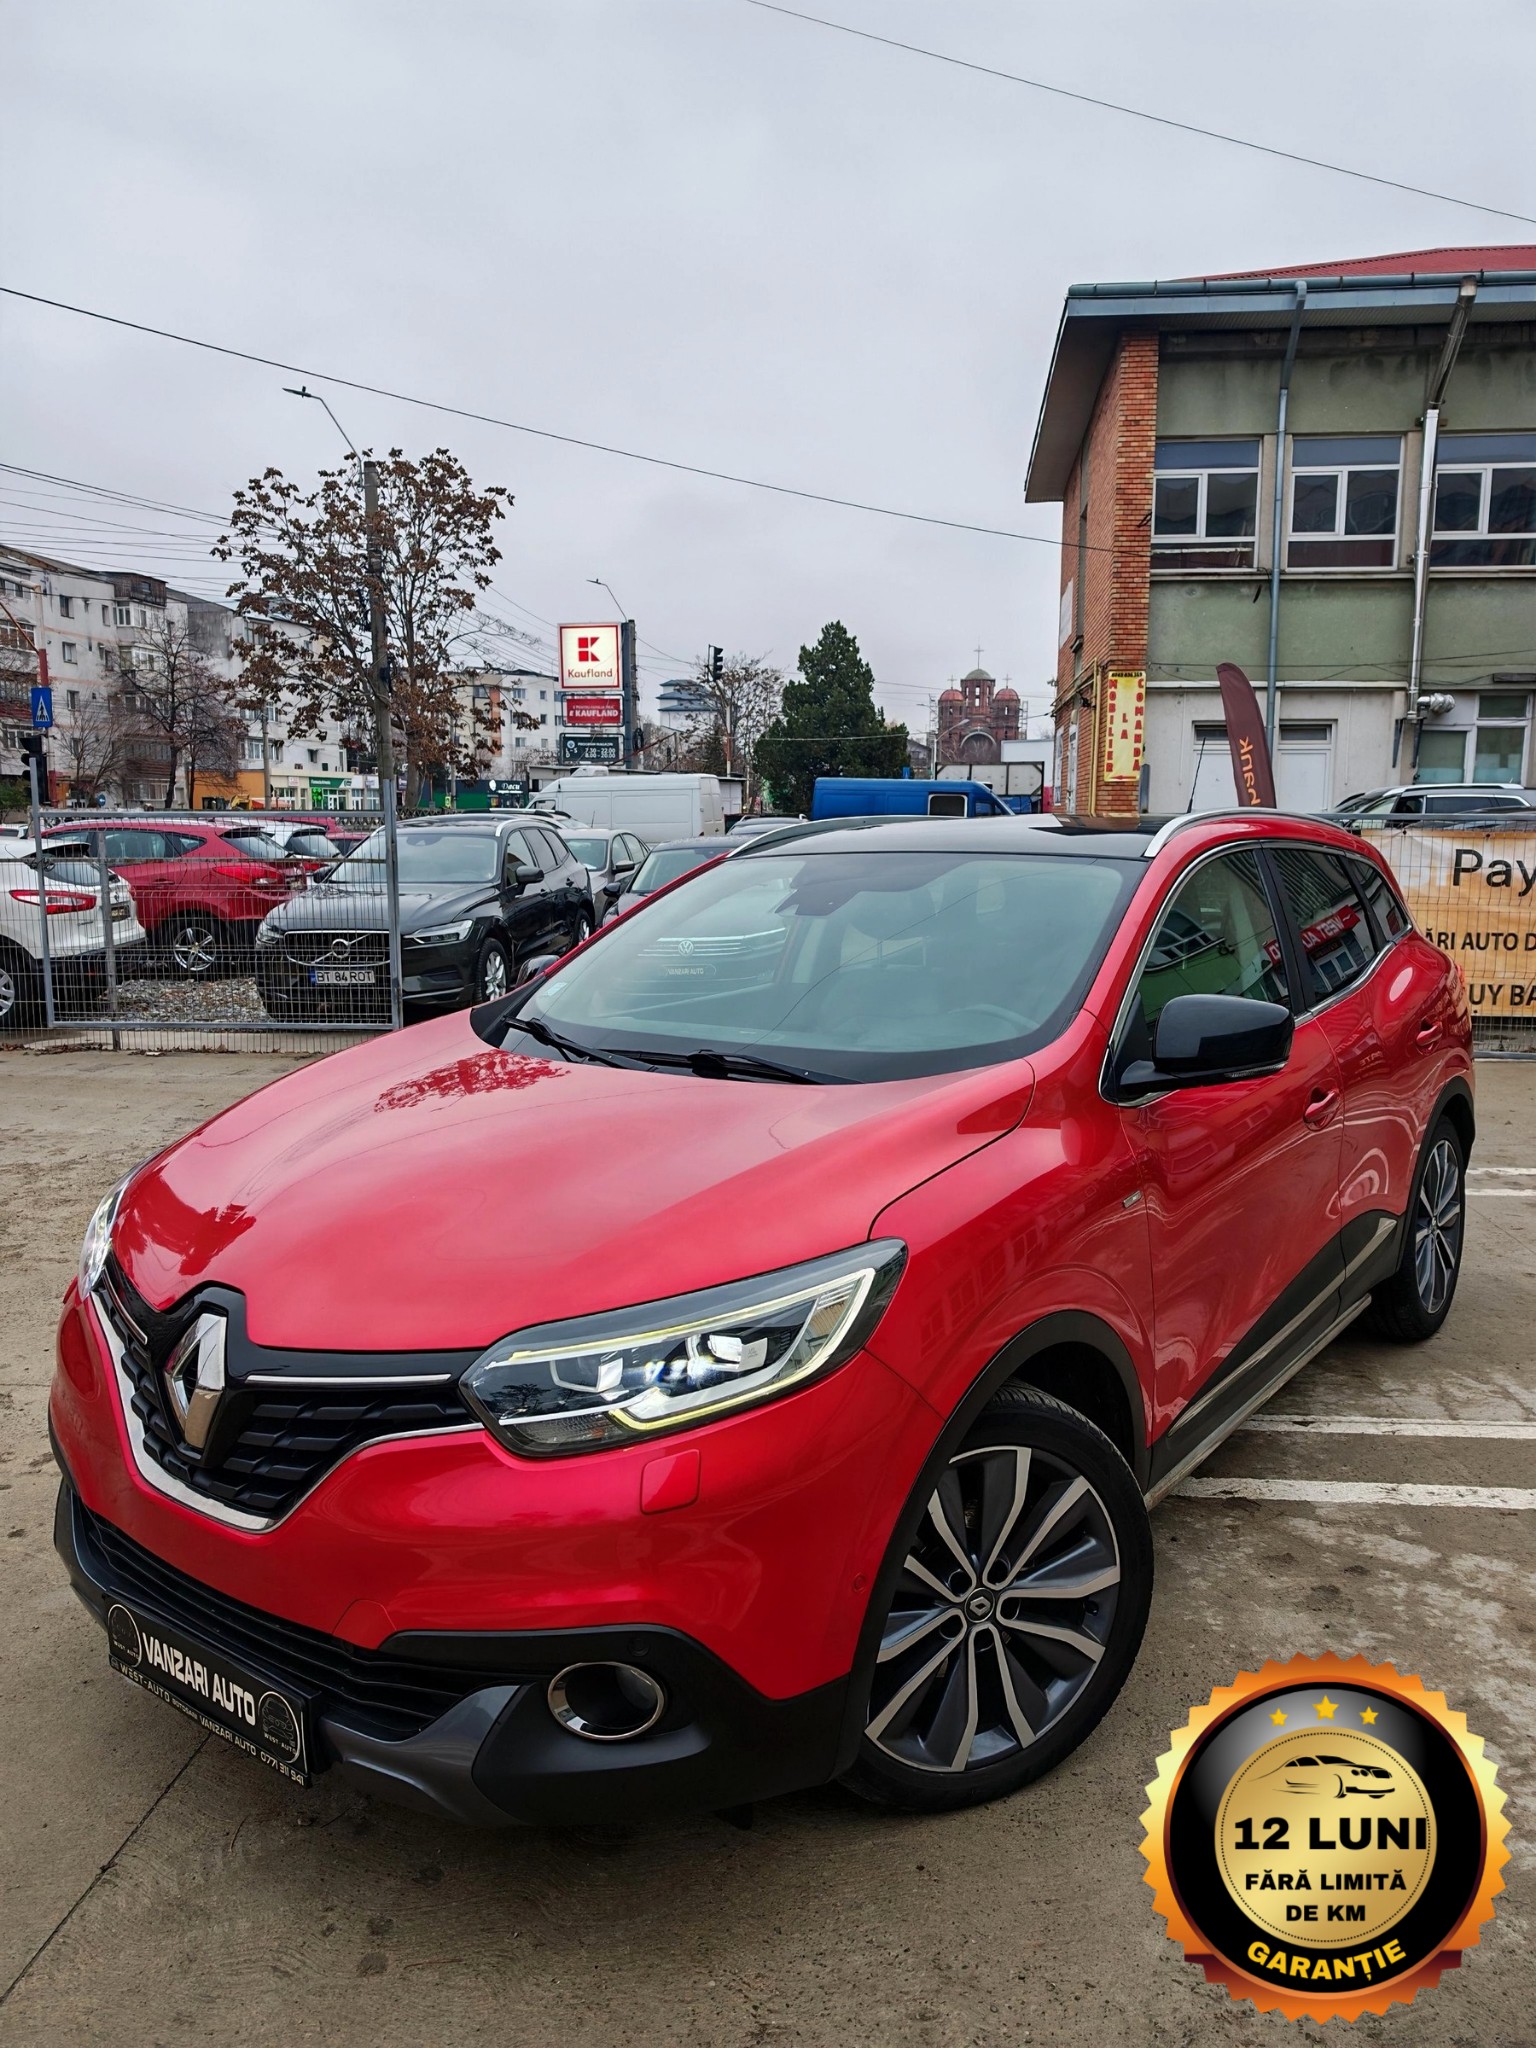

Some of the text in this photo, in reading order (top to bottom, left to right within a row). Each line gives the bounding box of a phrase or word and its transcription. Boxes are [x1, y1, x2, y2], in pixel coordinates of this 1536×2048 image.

[568, 668, 613, 678] Kaufland
[1106, 679, 1118, 772] MOBILIER
[1120, 713, 1128, 739] LA
[1452, 849, 1536, 897] Pay
[1461, 932, 1519, 951] AUTO
[317, 971, 372, 982] BT 84 ROT
[690, 967, 704, 975] AUTO
[142, 1632, 256, 1726] VANZARI AUTO
[120, 1663, 170, 1702] WEST-AUTO
[200, 1715, 233, 1743] VANZARI
[234, 1736, 256, 1756] AUTO
[260, 1751, 279, 1770] 0771
[264, 1732, 297, 1755] WEST AUTO
